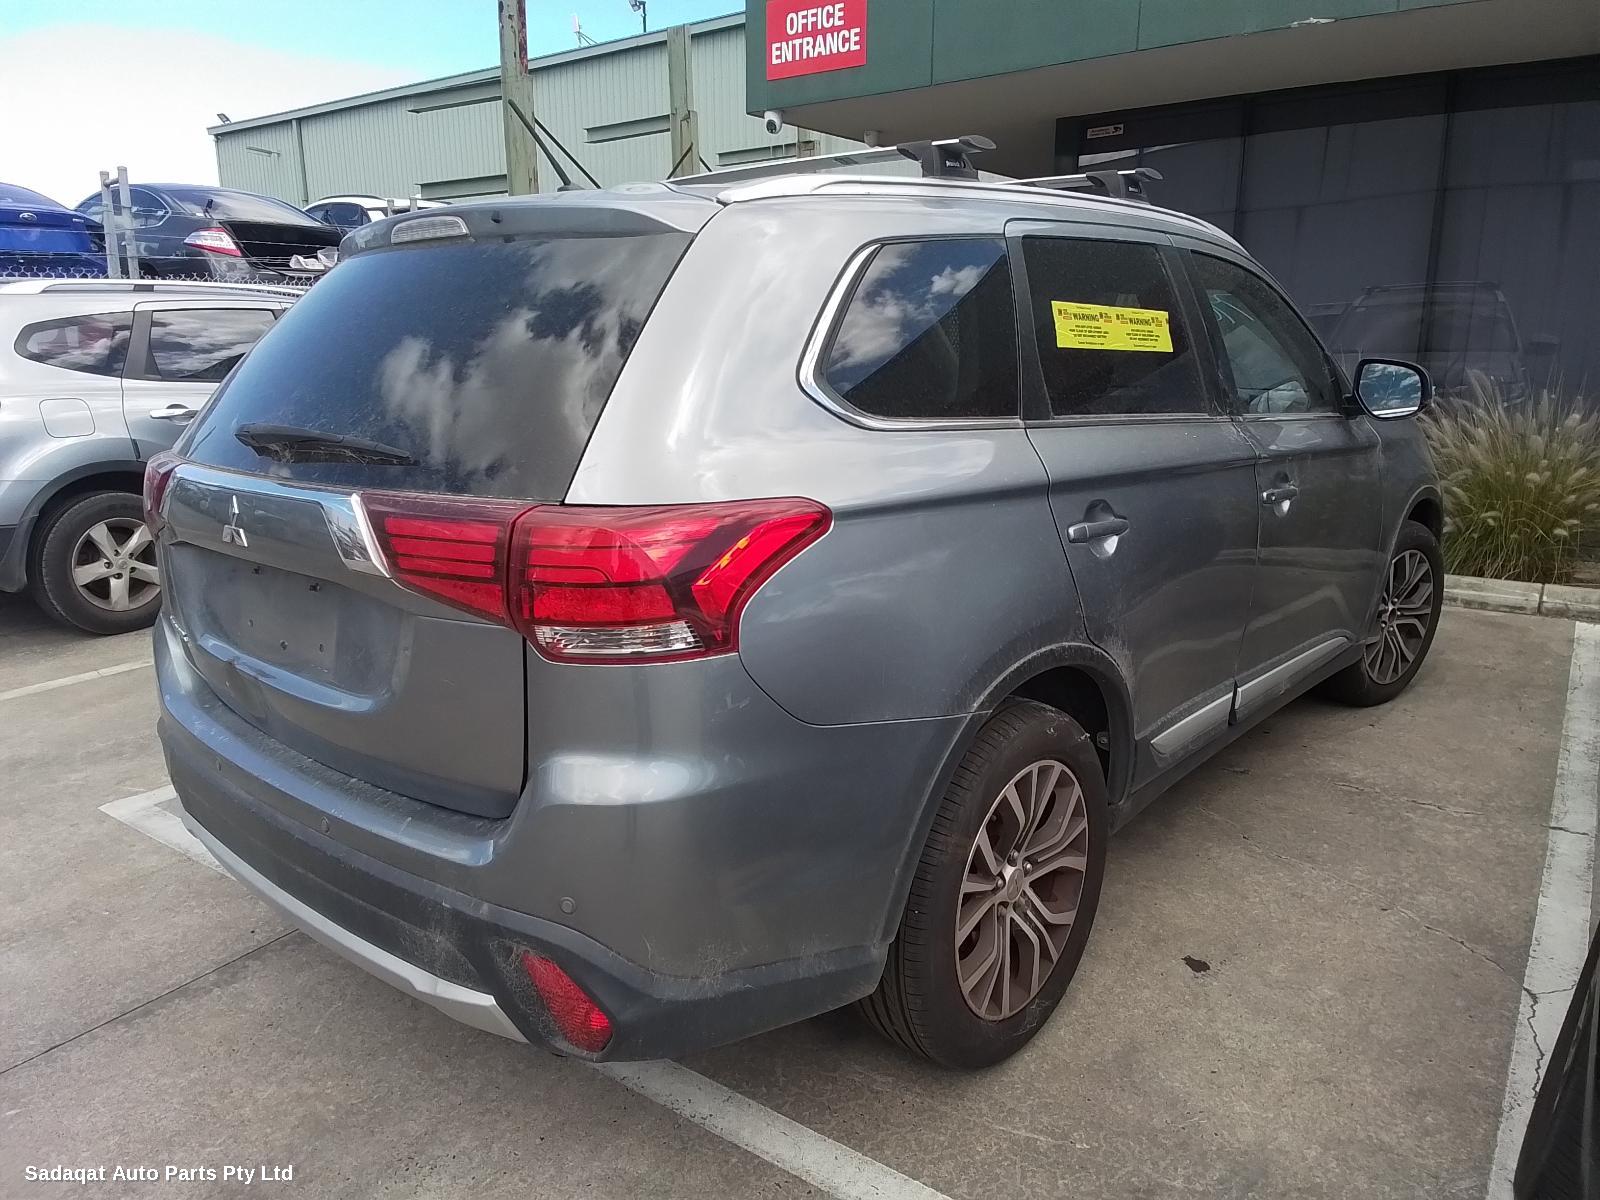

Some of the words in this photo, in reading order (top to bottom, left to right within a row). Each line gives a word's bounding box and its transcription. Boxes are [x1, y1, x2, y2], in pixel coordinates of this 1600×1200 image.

[786, 3, 845, 35] OFFICE
[771, 27, 861, 65] ENTRANCE
[1072, 312, 1100, 323] WARNING
[1128, 317, 1152, 327] WARNING
